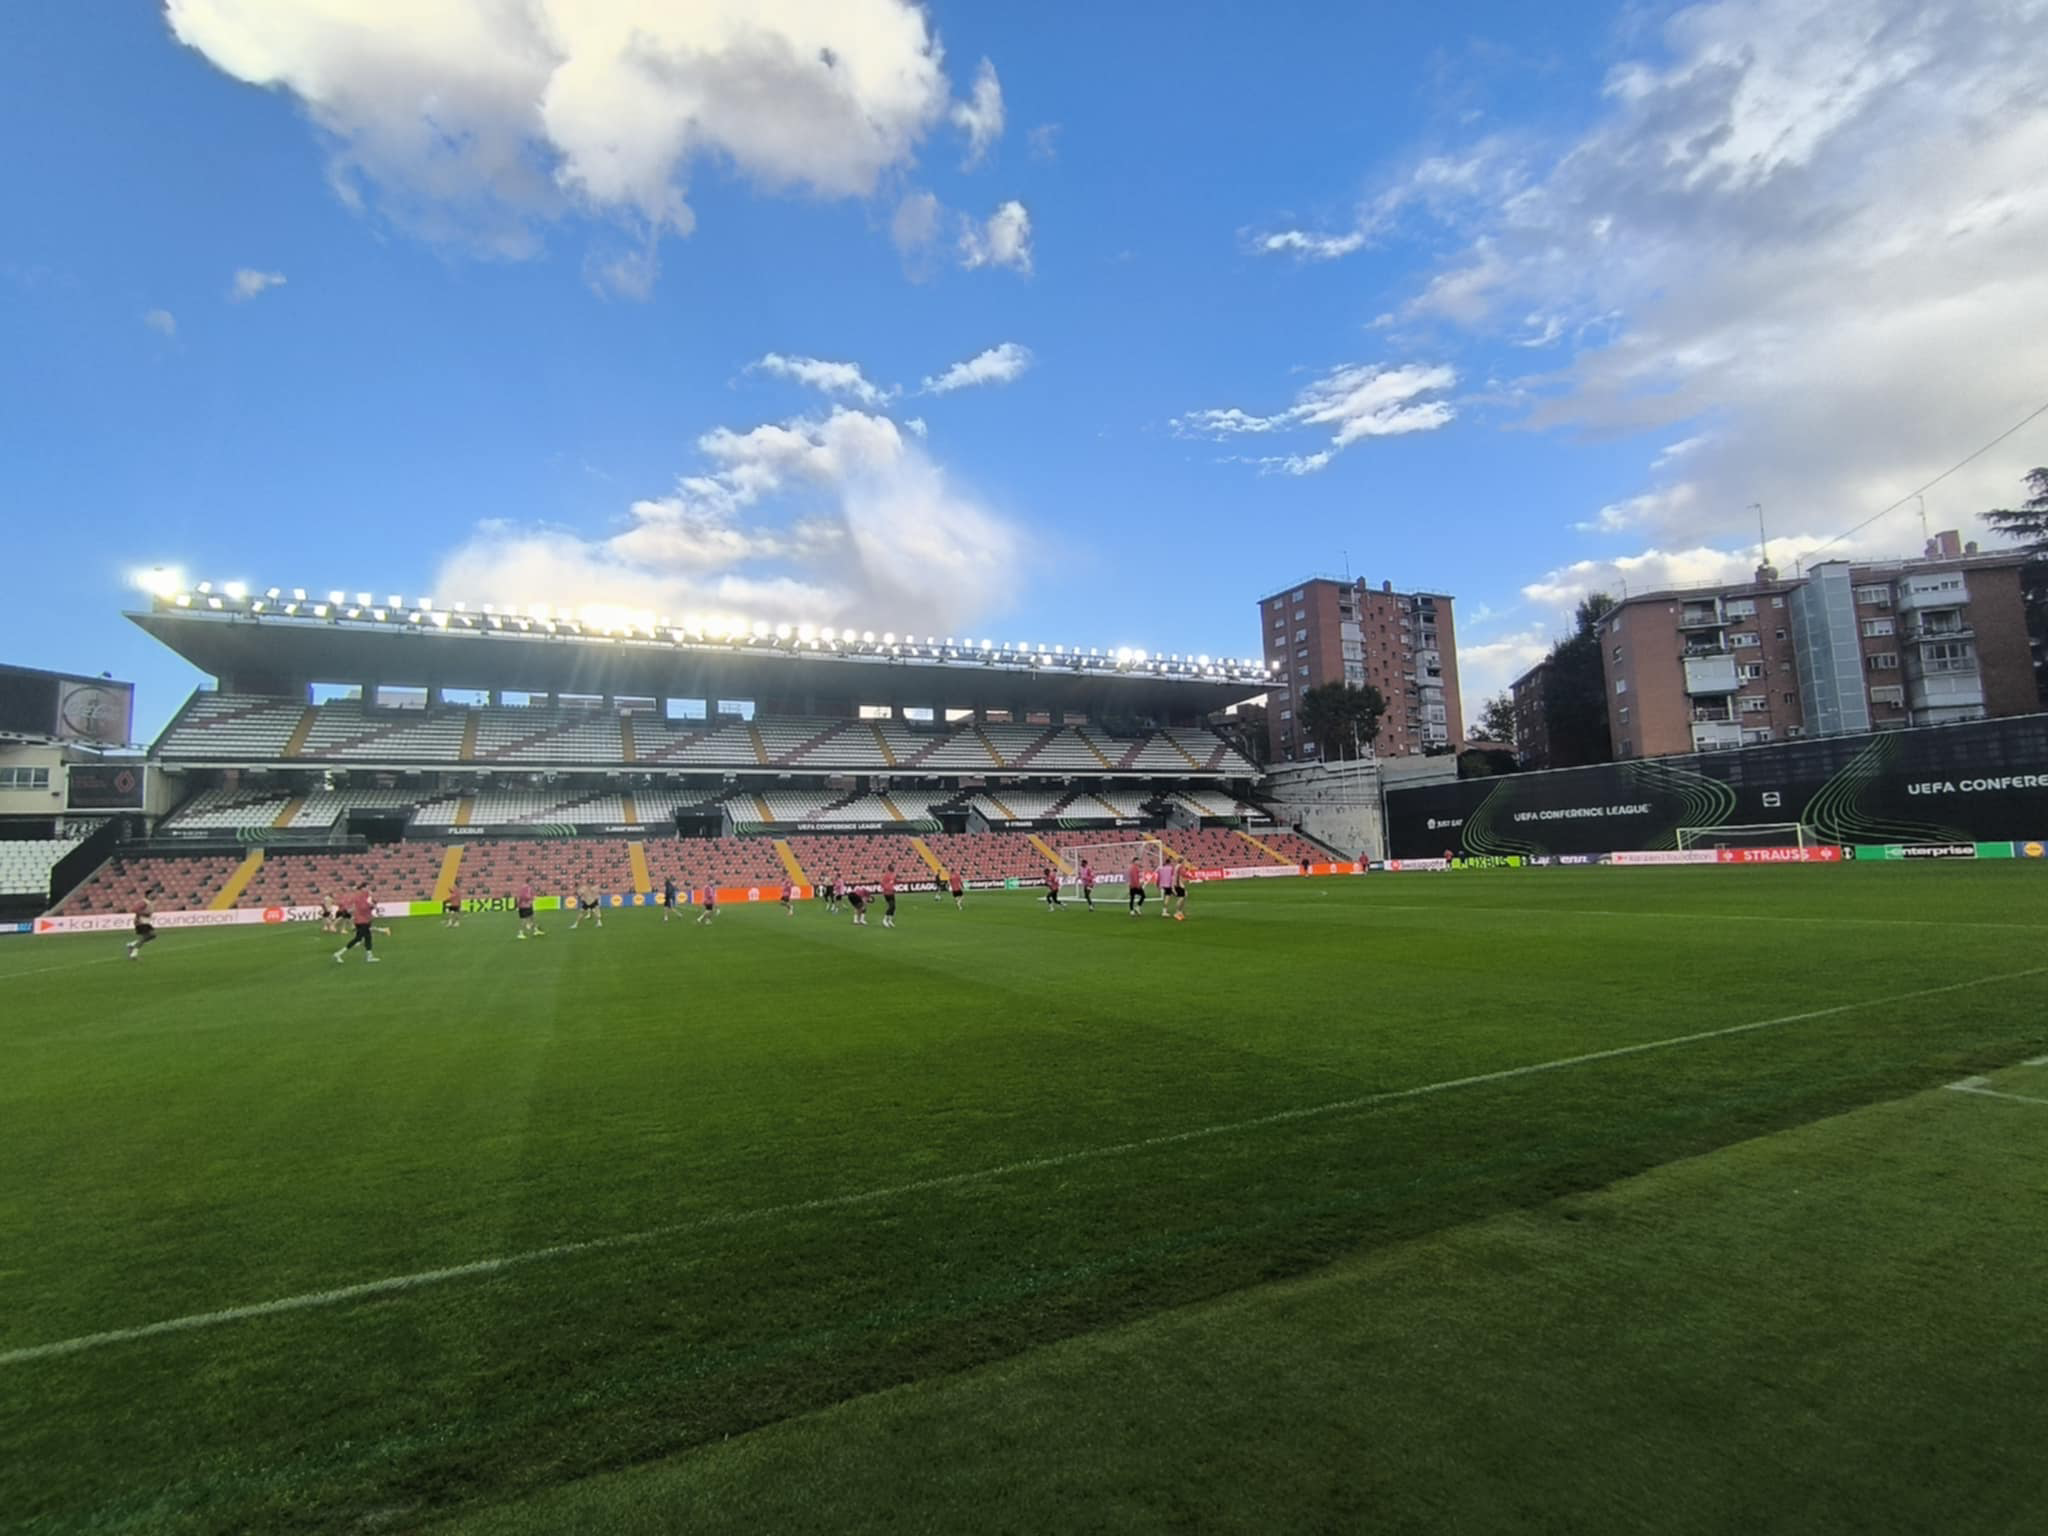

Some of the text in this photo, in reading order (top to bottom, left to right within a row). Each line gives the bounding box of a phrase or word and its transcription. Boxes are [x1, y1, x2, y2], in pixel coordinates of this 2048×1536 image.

[1907, 774, 2048, 795] UEFA CONFERE
[1514, 804, 1649, 822] UEFA CONFERENCE LEAGUE
[797, 822, 882, 831] UEFA CONFERENCE LEAGUE
[1743, 848, 1810, 862] STRAUSS
[1889, 844, 1974, 858] enterprise
[910, 882, 938, 892] LEAGU
